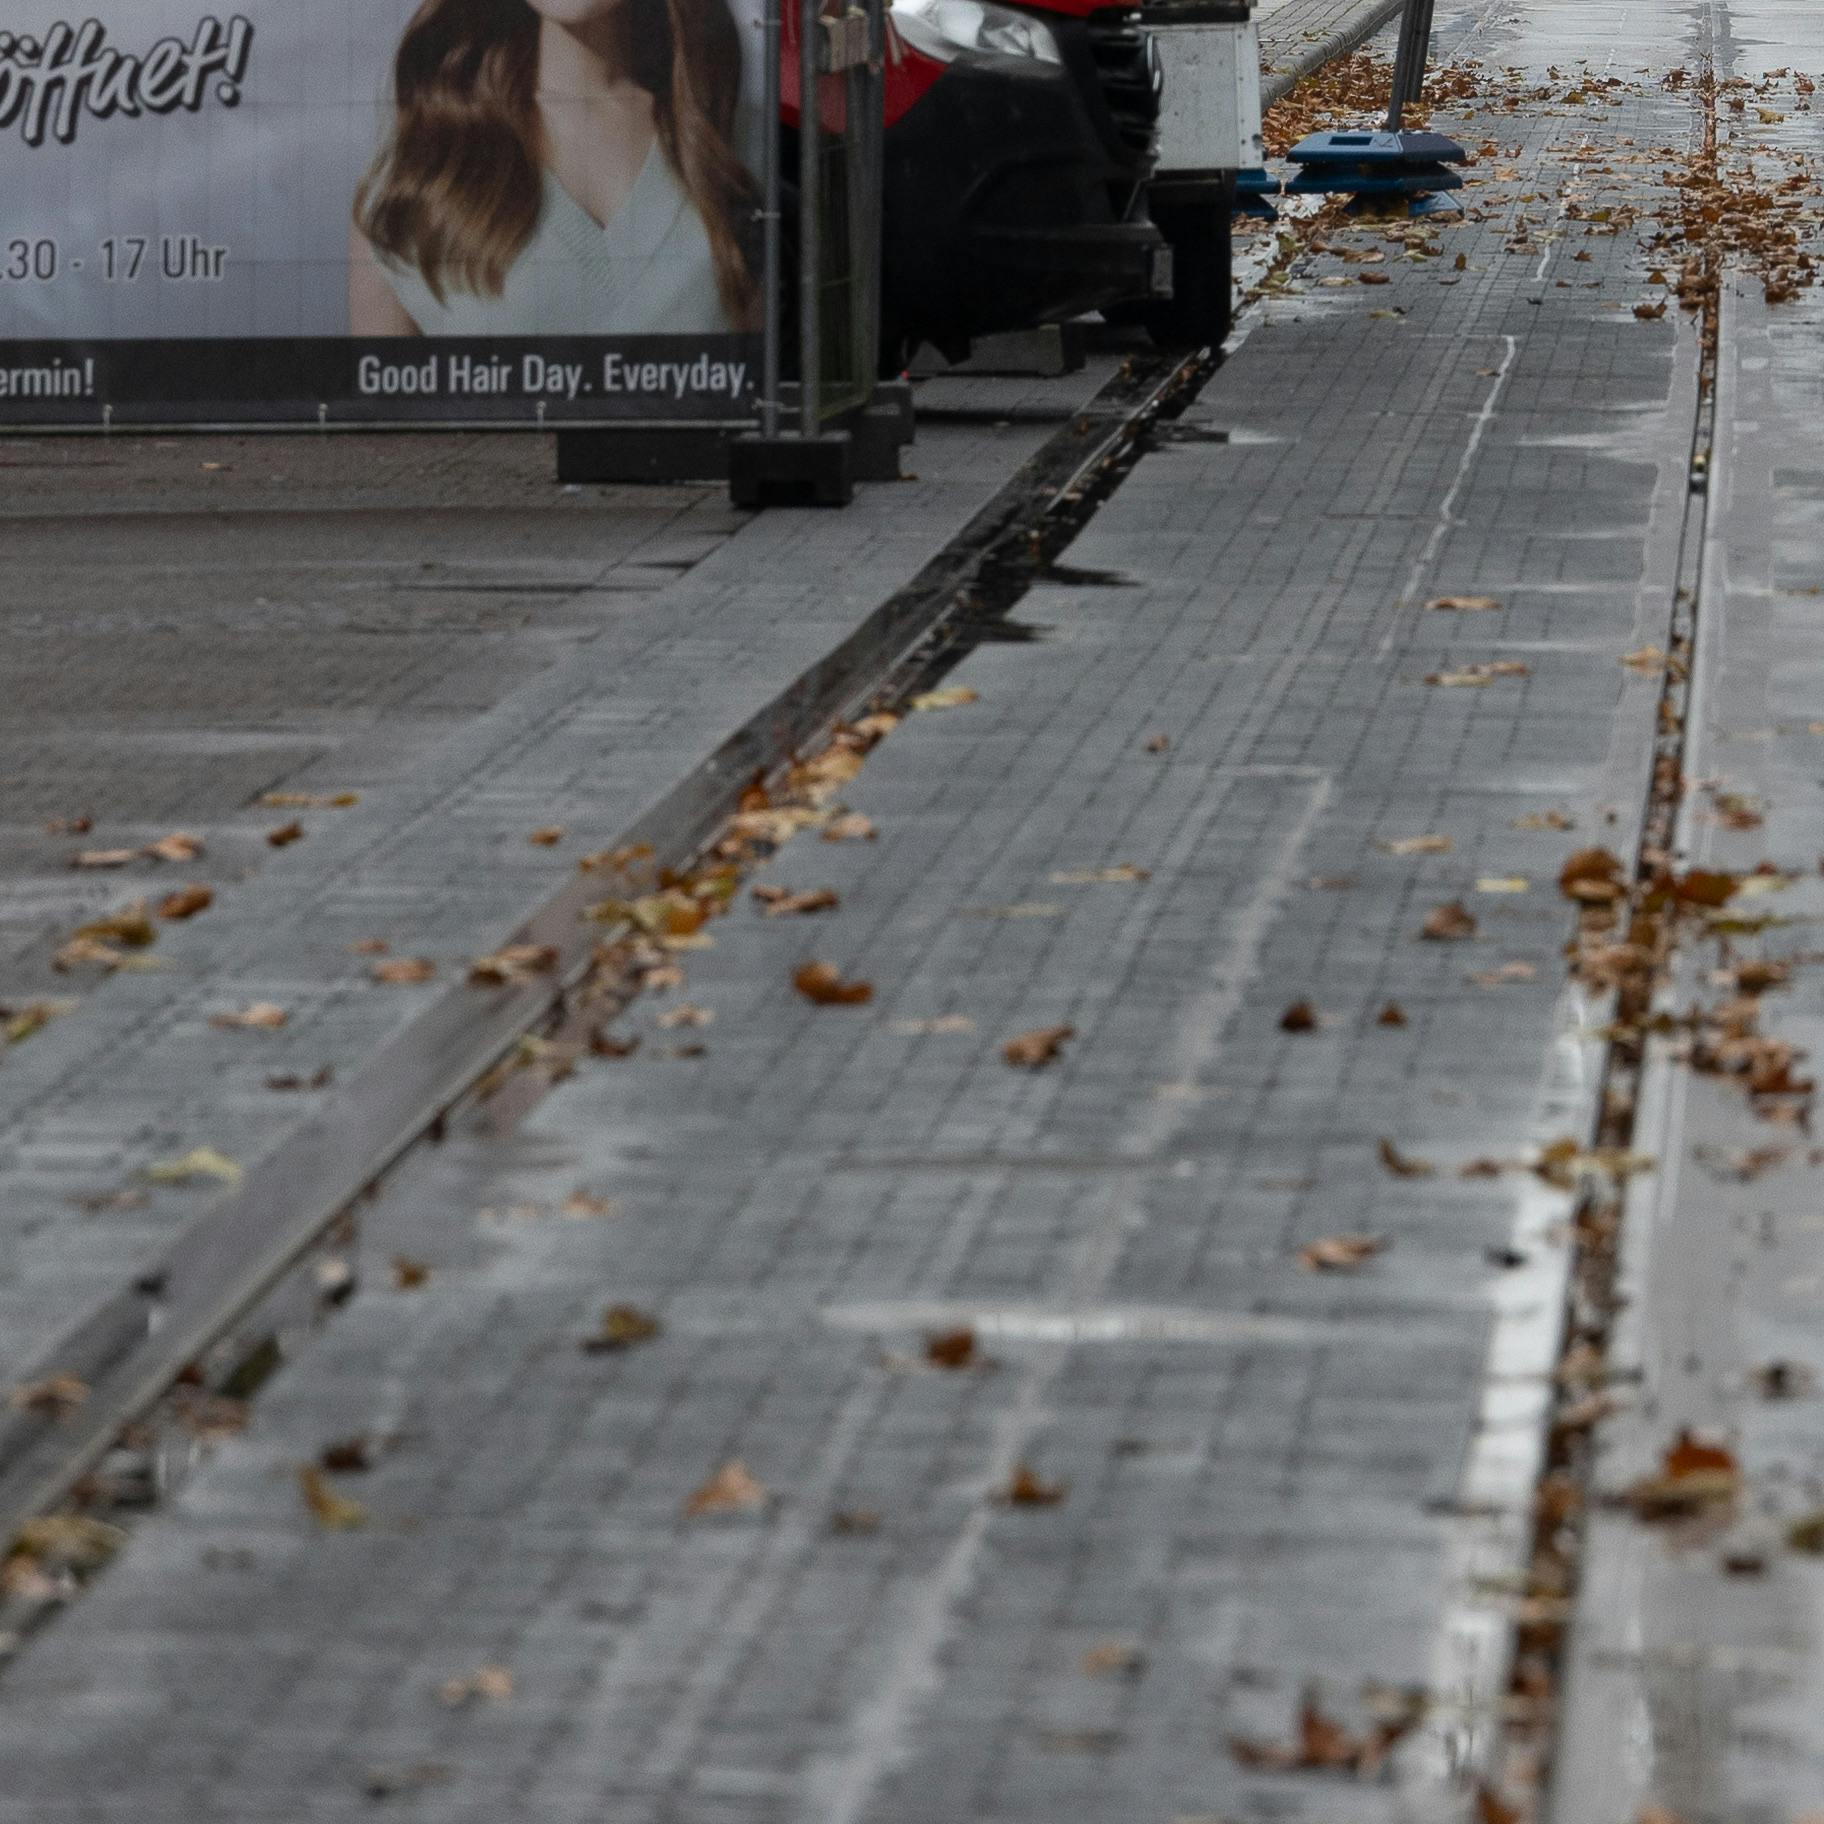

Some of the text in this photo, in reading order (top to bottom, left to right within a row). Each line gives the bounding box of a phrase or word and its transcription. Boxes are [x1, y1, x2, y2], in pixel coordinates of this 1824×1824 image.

[102, 238, 145, 280] 17
[162, 236, 227, 280] Uhr
[357, 353, 755, 401] Good Hair Day. Everyday.
